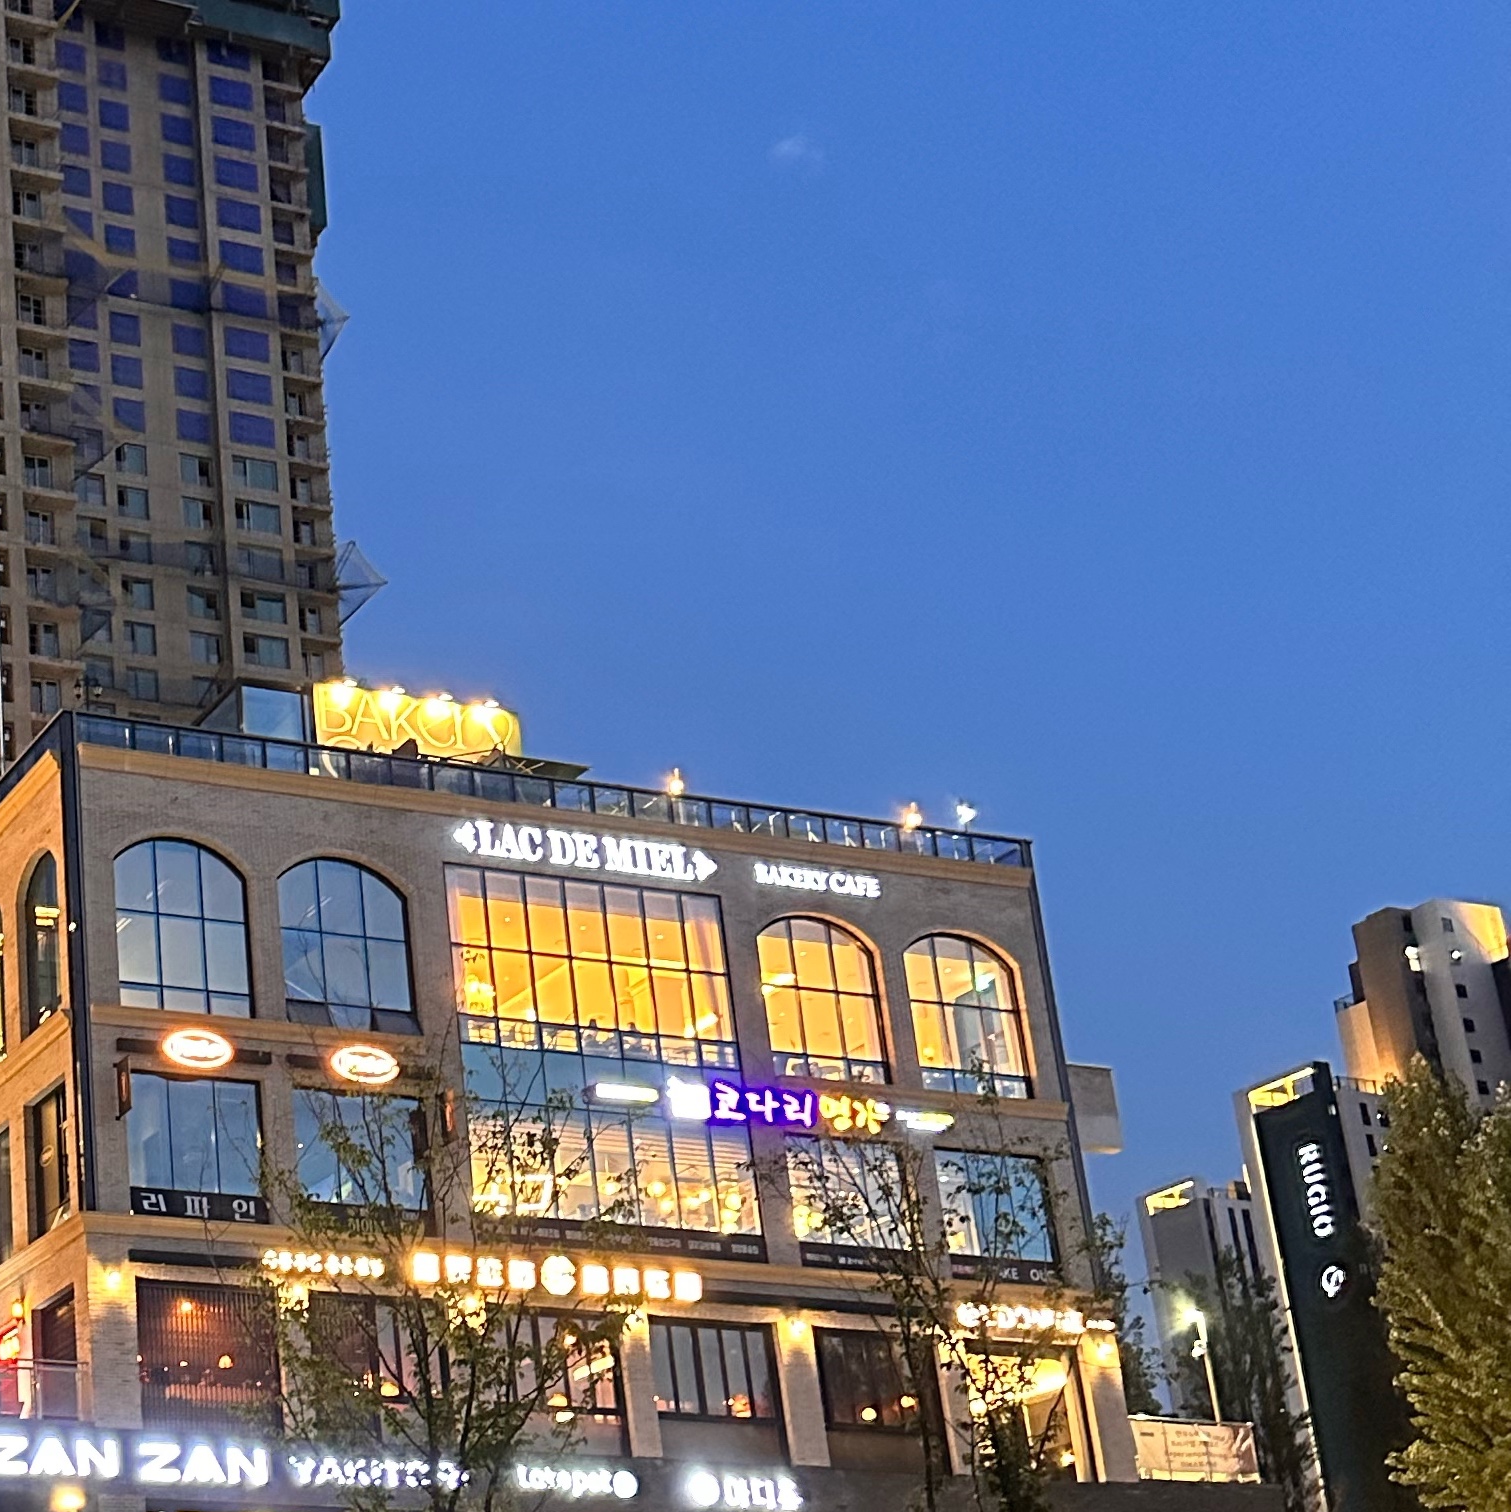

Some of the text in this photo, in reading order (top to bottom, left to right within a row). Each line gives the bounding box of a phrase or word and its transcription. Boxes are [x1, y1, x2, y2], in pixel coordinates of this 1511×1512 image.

[477, 819, 695, 882] LAC DE MIEL
[753, 862, 882, 899] BAKERY CAFE
[138, 1441, 271, 1487] ZAN
